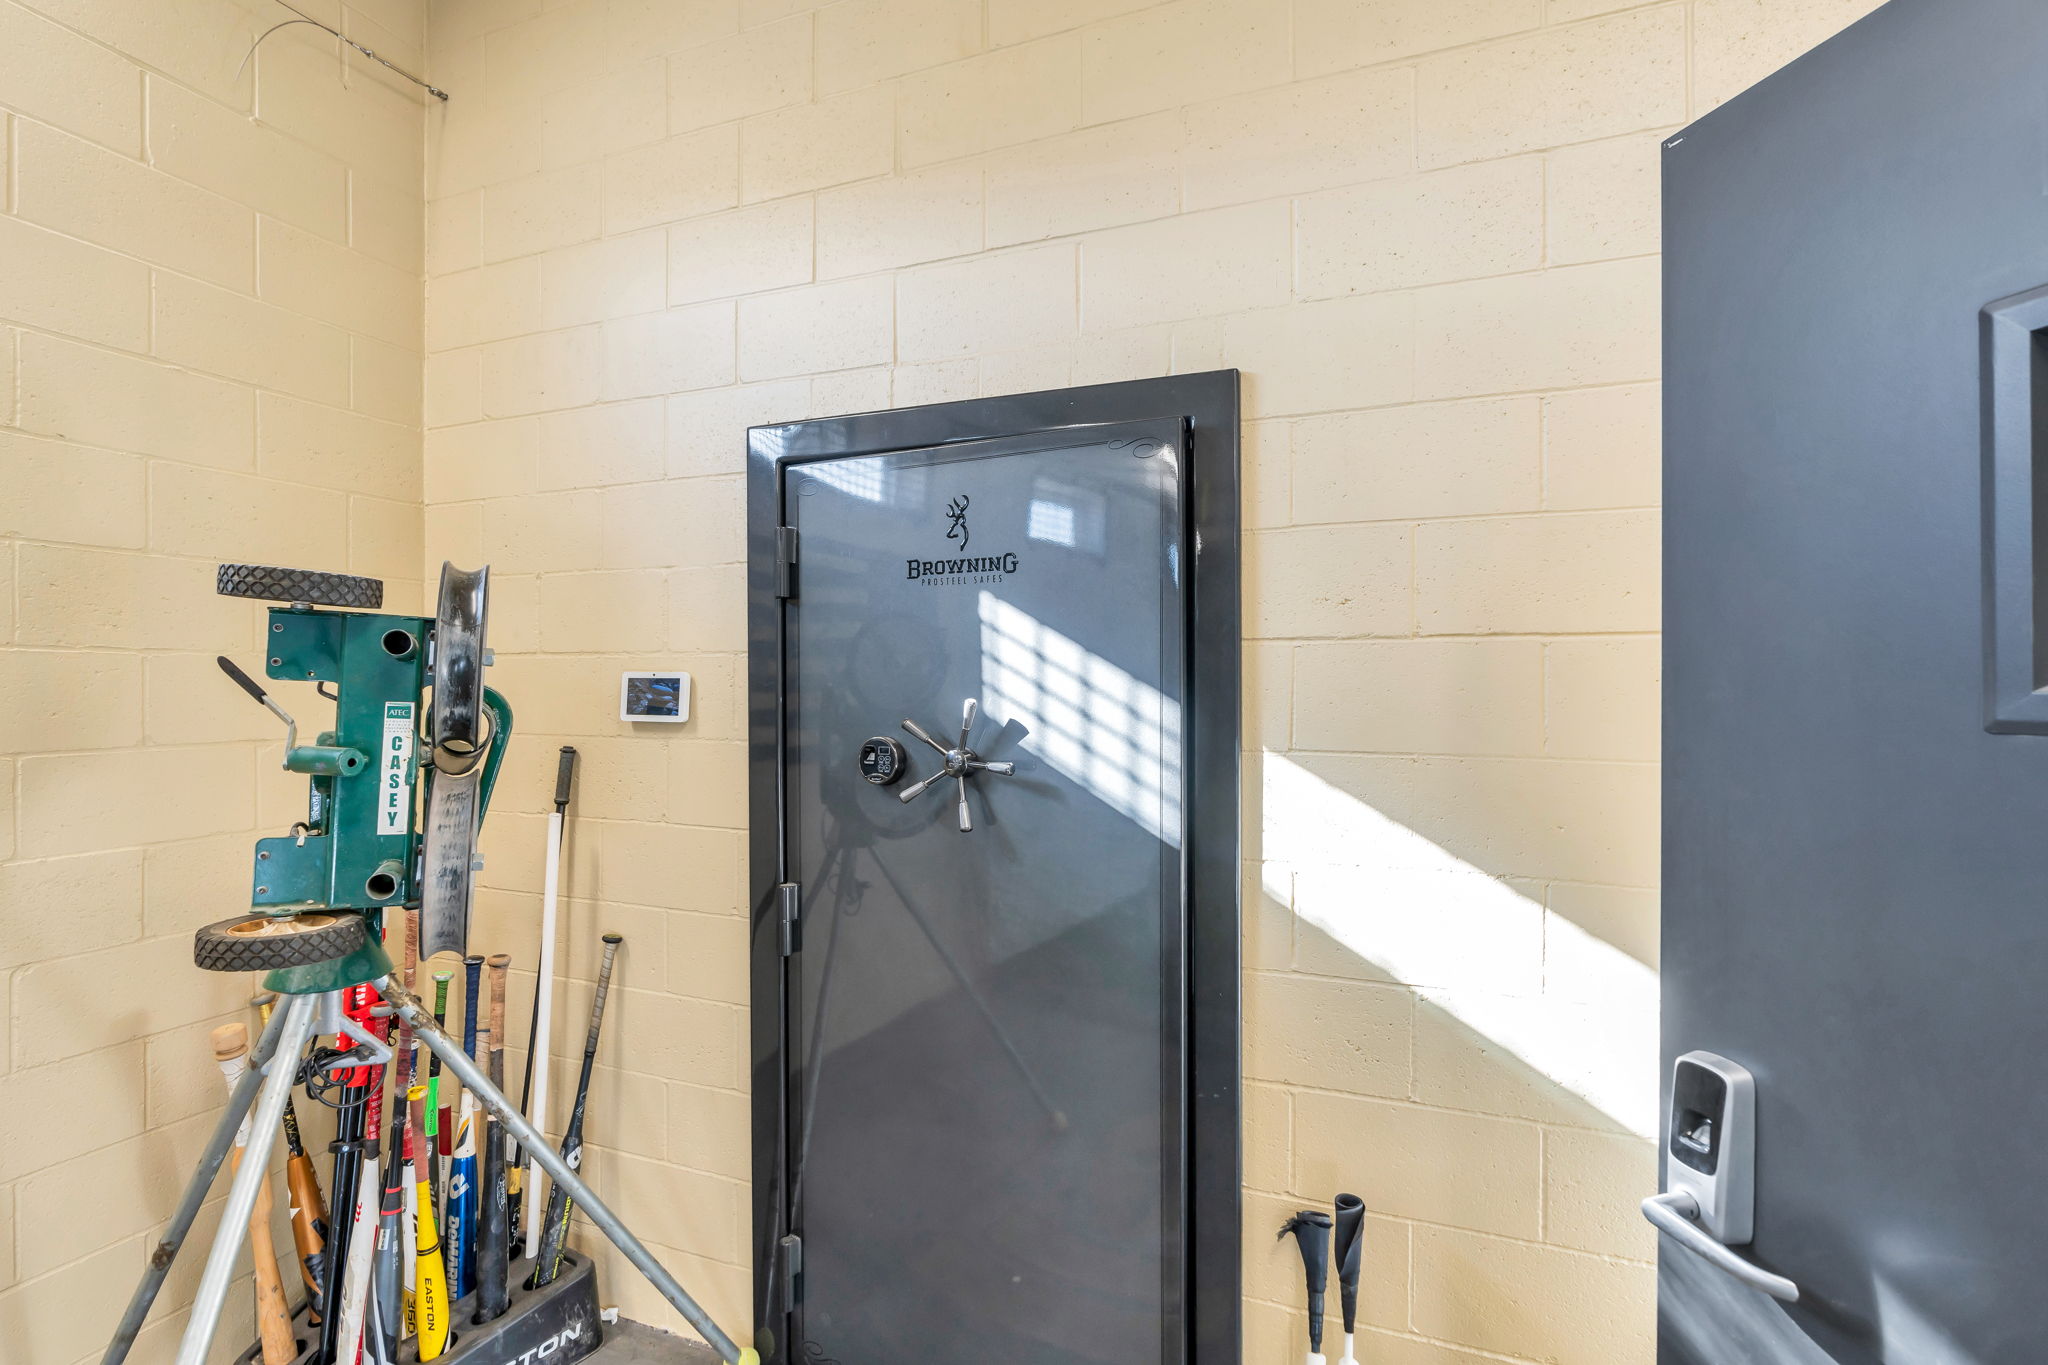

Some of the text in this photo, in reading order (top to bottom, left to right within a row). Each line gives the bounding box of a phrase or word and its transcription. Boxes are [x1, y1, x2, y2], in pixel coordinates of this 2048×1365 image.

[921, 574, 1003, 586] PROSTEEL SAFES
[388, 709, 410, 717] ATEC
[387, 735, 403, 827] CASEY
[424, 1277, 436, 1332] EASTON
[504, 1322, 582, 1365] TON
